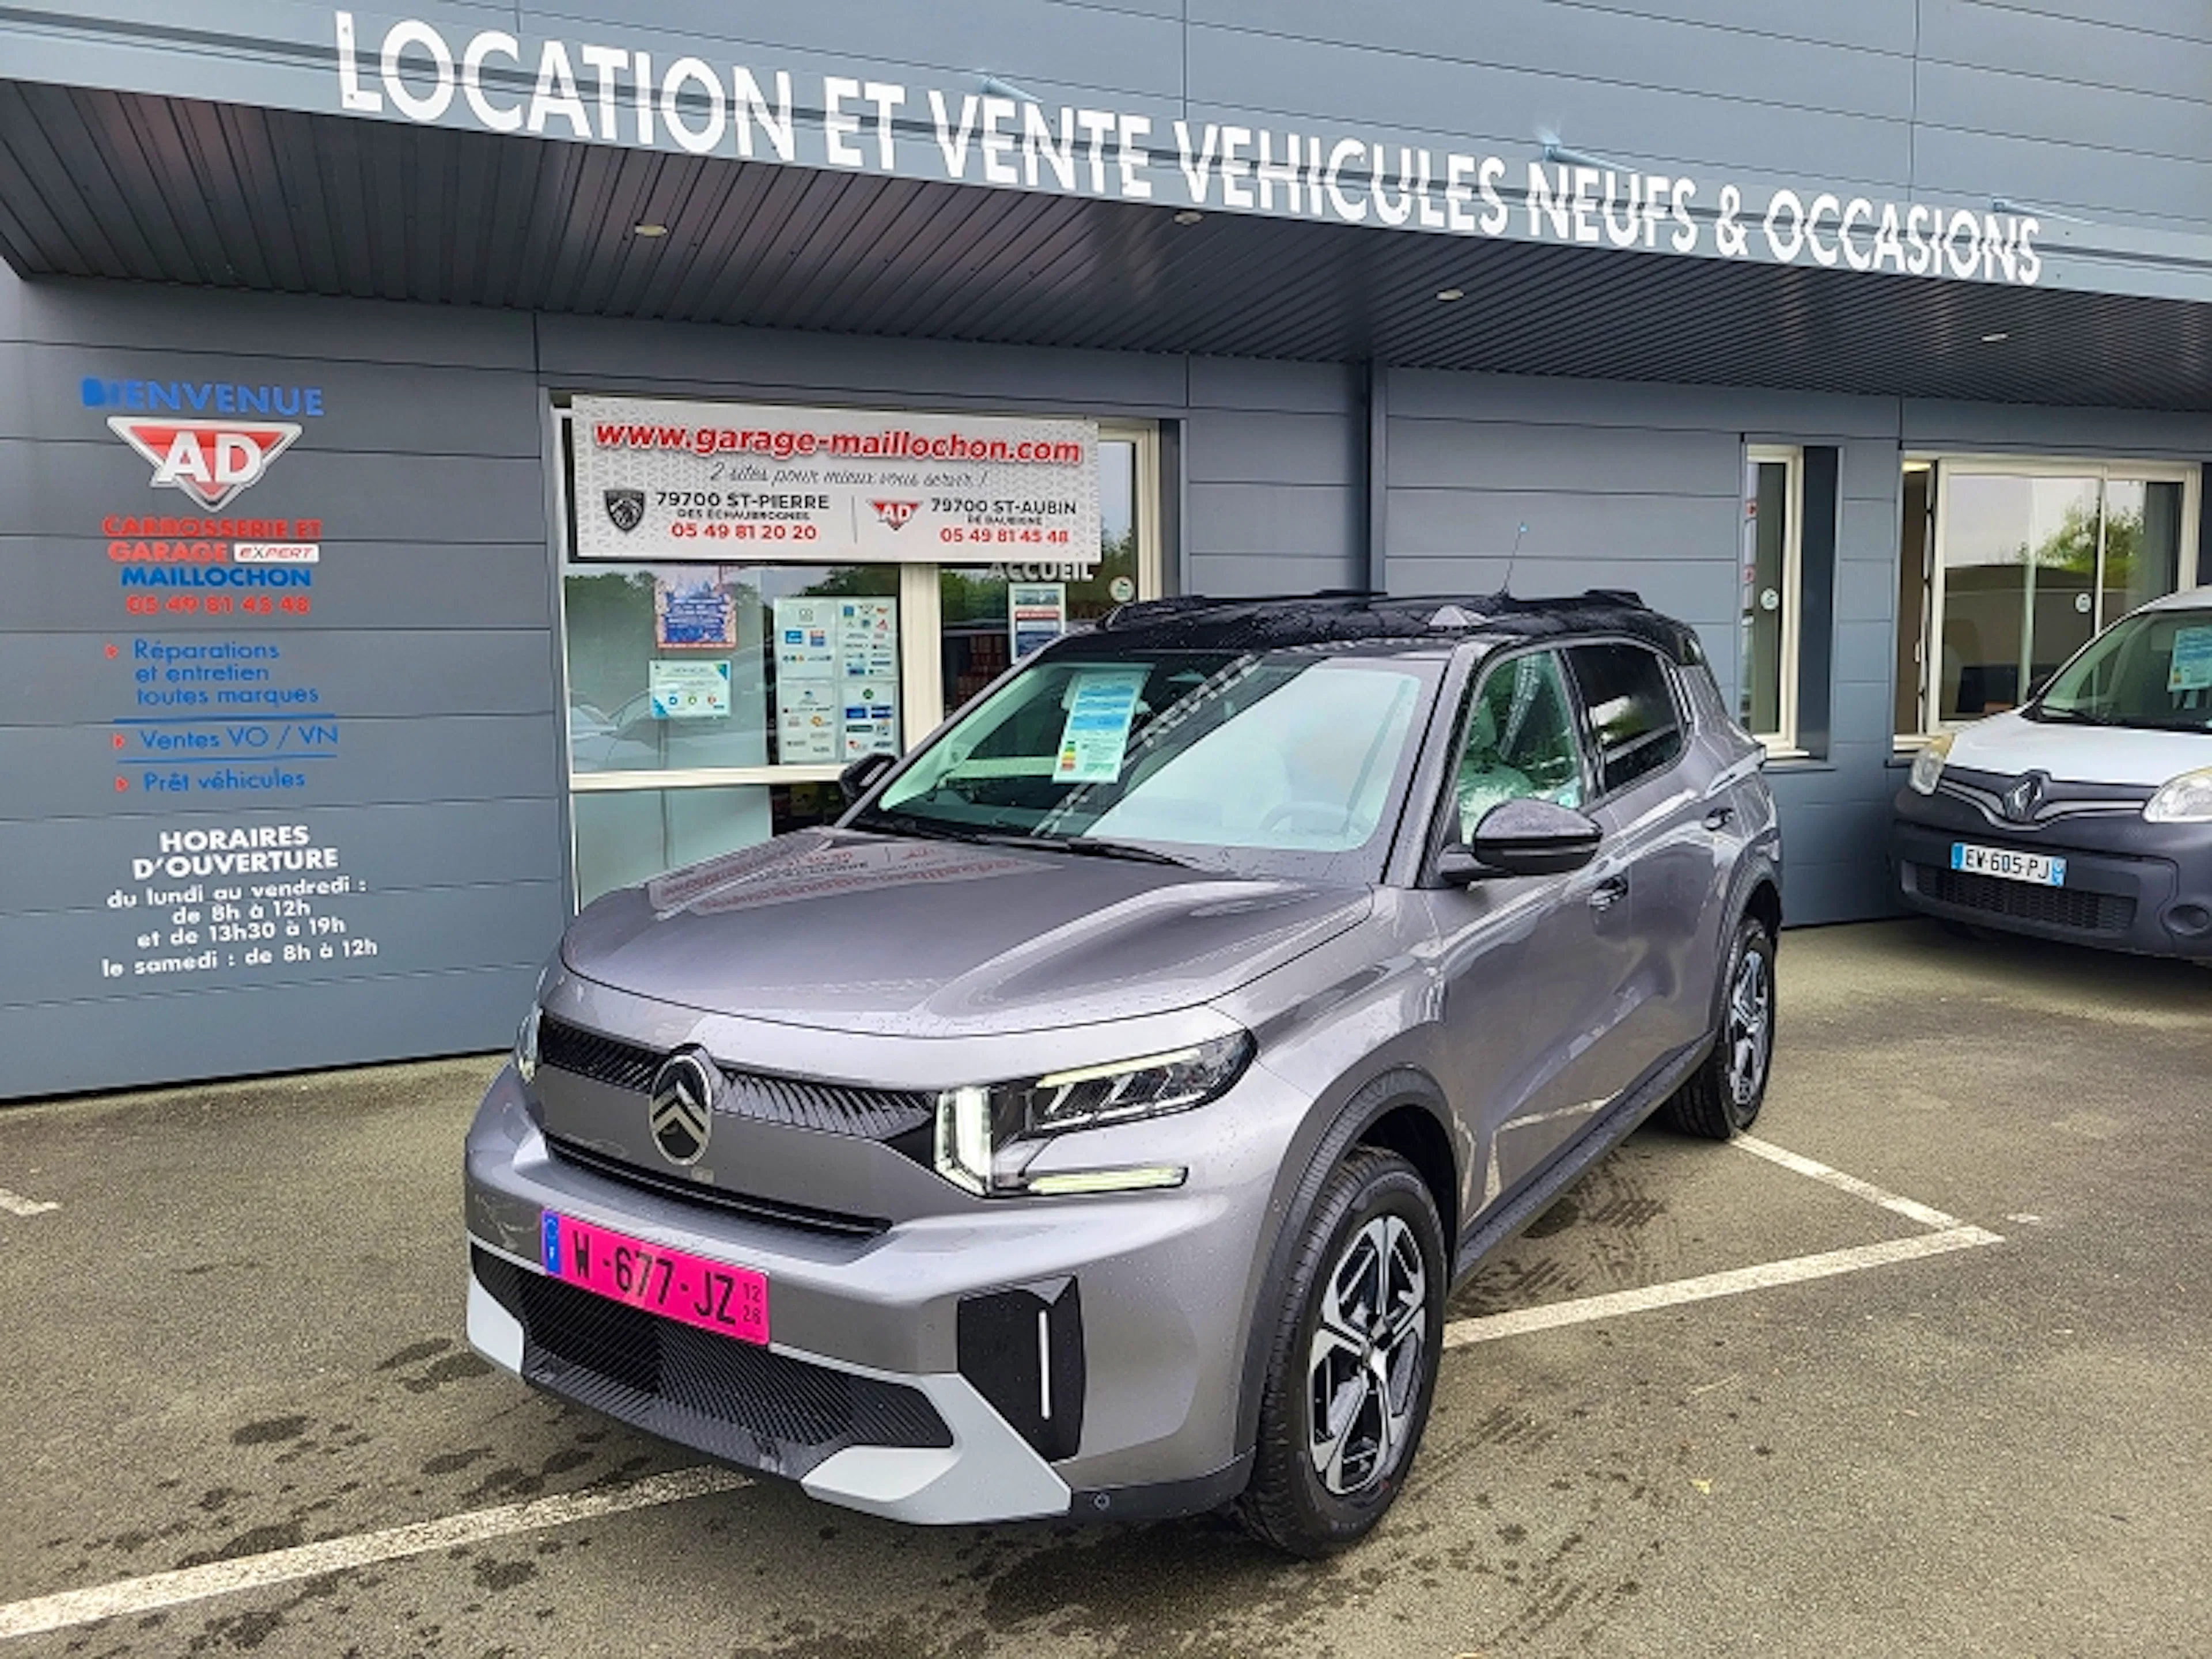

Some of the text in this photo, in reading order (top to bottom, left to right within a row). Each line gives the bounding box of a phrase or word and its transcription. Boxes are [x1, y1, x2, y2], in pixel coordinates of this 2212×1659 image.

[335, 10, 2042, 286] LOCATION ET VENTE VEHICULES NEUFS & OCCASIONS
[594, 422, 1083, 464] www.garage-maillochon.com
[153, 431, 264, 484] AD
[710, 461, 725, 481] 2
[656, 492, 721, 506] 79700
[726, 493, 830, 509] ST-PIERRE
[931, 498, 1077, 515] 79700 ST-AUBIN
[876, 505, 912, 522] AD
[295, 518, 323, 539] ET
[671, 522, 817, 540] 05 49 81 20 20
[940, 528, 963, 543] 05
[969, 528, 991, 543] 49
[997, 528, 1016, 543] 81
[107, 541, 229, 562] GARAGE
[120, 566, 312, 587] MAILLOCHON
[987, 562, 1094, 582] ACCUEIL
[126, 594, 159, 615] 05
[165, 594, 199, 615] 49
[204, 595, 233, 615] 81
[279, 595, 311, 615] 48
[134, 639, 281, 664] Réparations
[134, 664, 269, 683] et entretien
[137, 687, 320, 707] toutes marques
[138, 729, 221, 750] Ventes
[225, 726, 269, 747] VO
[298, 725, 339, 745] VN
[142, 768, 306, 792] Prêt véhicules
[159, 825, 311, 853] HORAIRES
[131, 847, 340, 880] D'OUVERTURE
[107, 889, 137, 910] du
[146, 885, 204, 906] lundi
[213, 886, 242, 902] au
[251, 875, 351, 897] vendredi
[172, 897, 312, 926] de 8h à 12h
[136, 914, 346, 949] et de 13h30 à 19h
[101, 957, 124, 978] le
[134, 949, 218, 976] samedi
[245, 946, 272, 966] de
[283, 941, 312, 963] 8h
[319, 940, 334, 959] à
[341, 936, 378, 958] 12h
